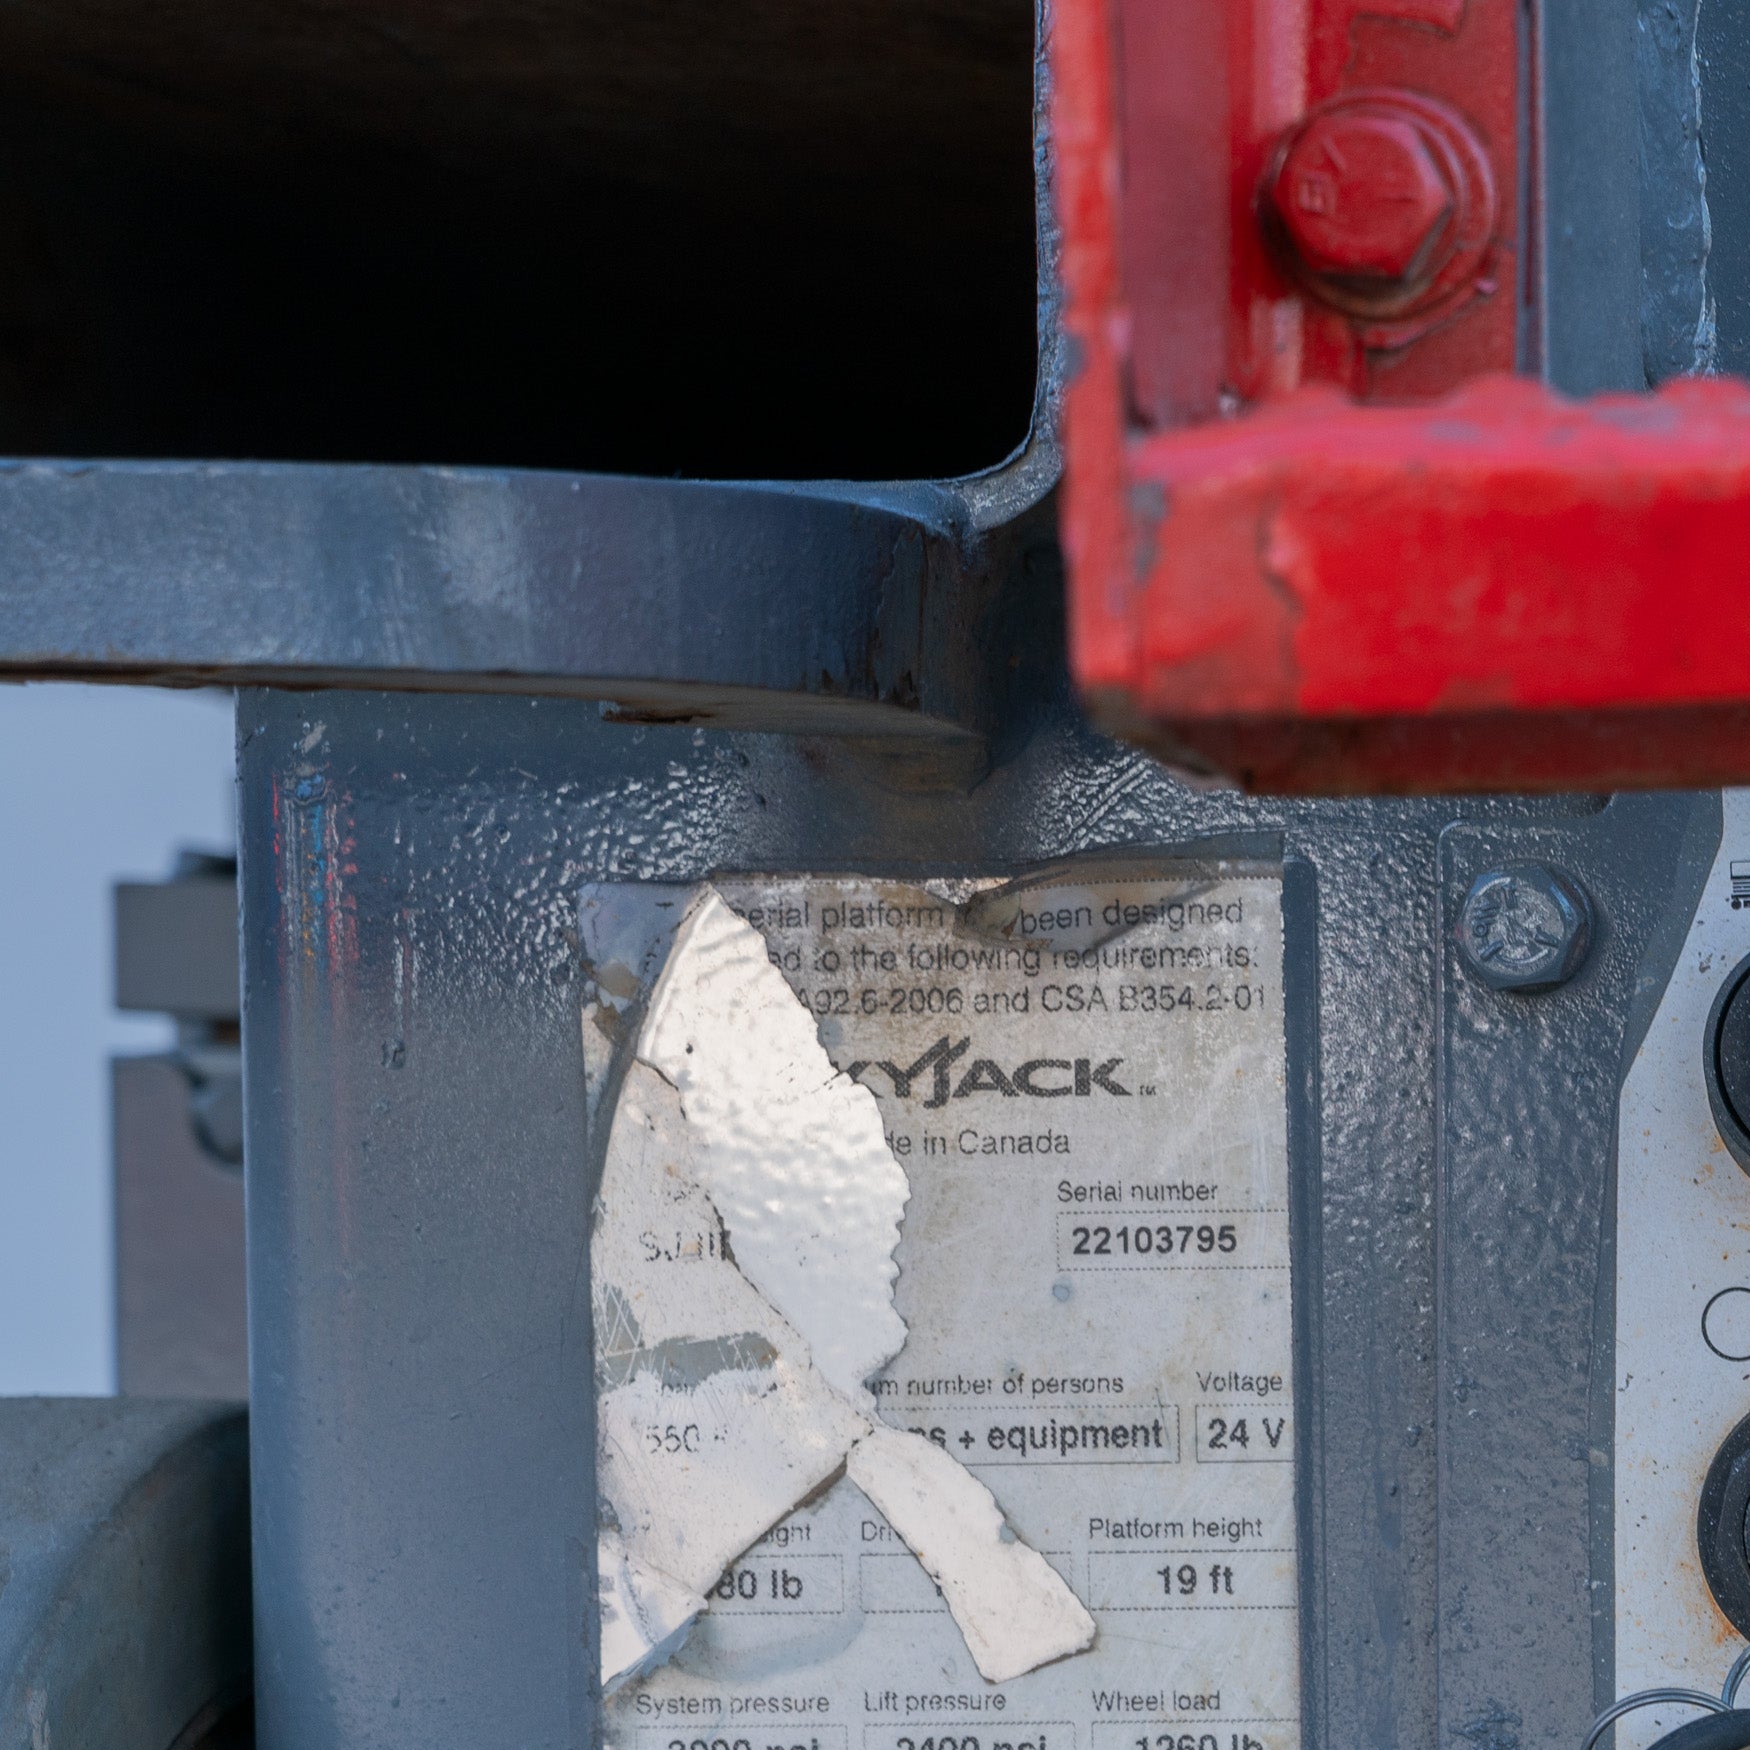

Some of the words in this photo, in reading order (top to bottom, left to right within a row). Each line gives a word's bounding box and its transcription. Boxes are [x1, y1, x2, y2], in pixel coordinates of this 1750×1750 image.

[822, 899, 943, 934] platform
[1021, 908, 1092, 934] been
[1103, 898, 1243, 932] designed
[814, 945, 841, 972] to
[851, 943, 897, 972] the
[908, 942, 1041, 977] following
[974, 985, 1030, 1013] and
[1042, 984, 1109, 1012] CSA
[924, 1130, 947, 1156] in
[958, 1129, 1071, 1156] Canada
[1057, 1180, 1122, 1203] Serial
[1130, 1180, 1218, 1201] number
[1072, 1225, 1237, 1255] 22103795
[907, 1374, 991, 1396] number
[1002, 1373, 1024, 1395] of
[1032, 1375, 1124, 1399] persons
[1198, 1371, 1283, 1397] Voltage
[987, 1418, 1164, 1457] equipment
[1208, 1417, 1250, 1449] 24
[1262, 1417, 1286, 1448] V
[1089, 1517, 1184, 1540] Platform
[1192, 1517, 1263, 1545] height
[772, 1569, 804, 1600] lb
[1157, 1564, 1197, 1596] 19
[1208, 1565, 1235, 1595] ft
[636, 1693, 722, 1720] System
[730, 1695, 831, 1721] pressure
[864, 1690, 899, 1711] Lift
[906, 1692, 1007, 1716] pressure
[1092, 1690, 1164, 1712] Wheel
[1172, 1689, 1221, 1711] load
